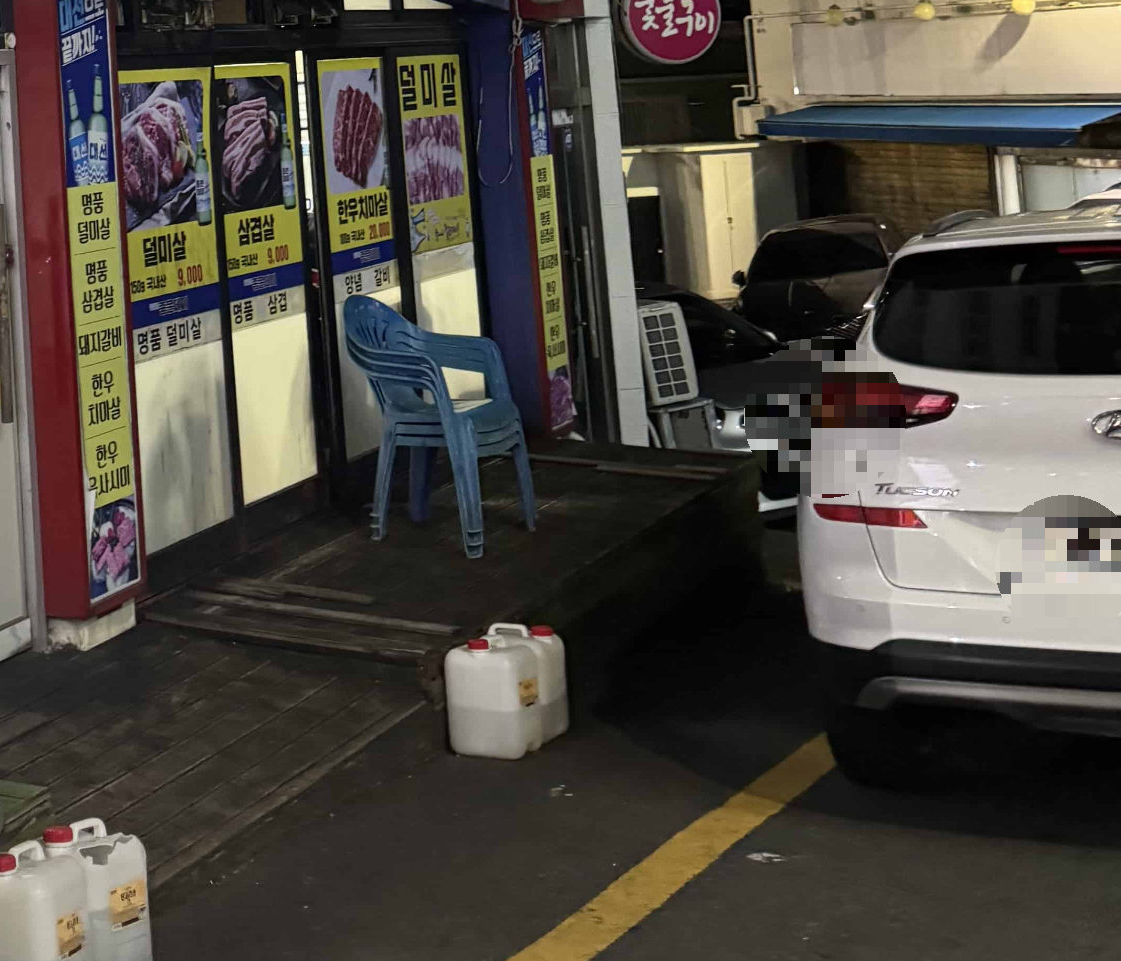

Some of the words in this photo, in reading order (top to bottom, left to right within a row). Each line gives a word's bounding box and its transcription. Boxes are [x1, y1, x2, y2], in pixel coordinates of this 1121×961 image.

[399, 62, 456, 112] 덜미살
[81, 192, 104, 216] 명품
[337, 191, 389, 226] 한우치마살
[77, 217, 111, 244] 덜미살
[238, 213, 275, 247] 삼겹살
[142, 230, 186, 268] 덜미살
[85, 259, 108, 285] 명품
[146, 274, 167, 291] 국내산
[344, 272, 363, 295] 양념
[374, 265, 391, 288] 갈비
[81, 286, 115, 314] 삼겹살
[233, 299, 254, 325] 명품
[267, 291, 288, 316] 삼겹
[78, 326, 122, 356] 돼지갈비
[138, 328, 161, 356] 명품
[166, 317, 202, 348] 덜미살
[91, 370, 114, 398] 한우
[87, 396, 121, 427] 치마살
[95, 440, 119, 469] 한우
